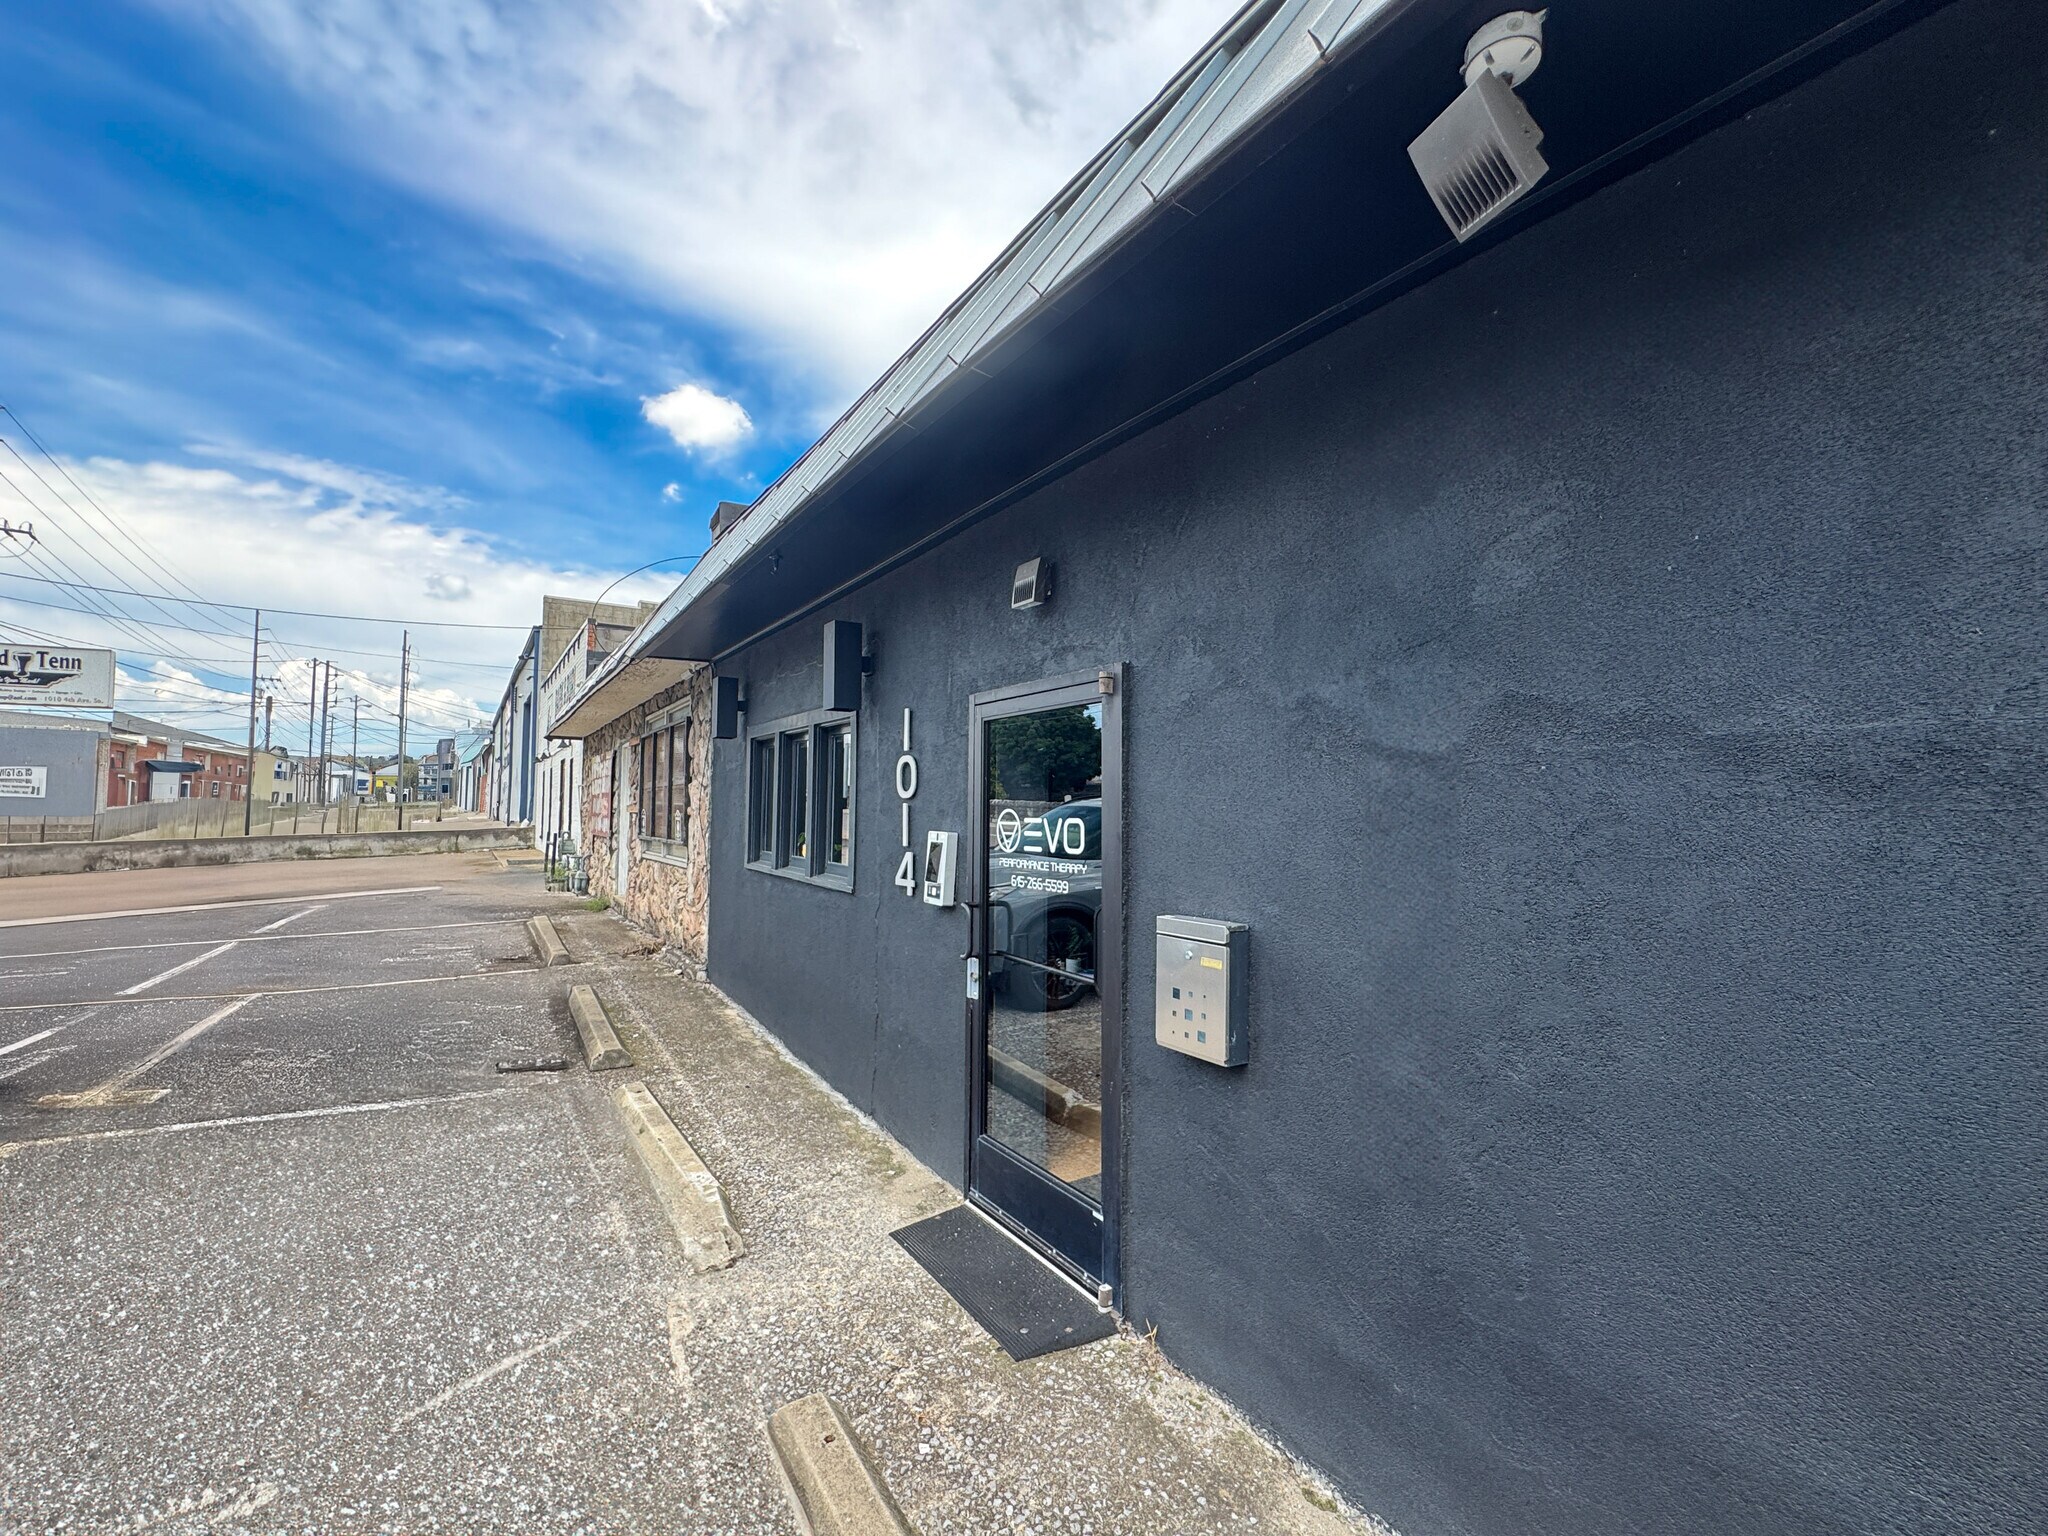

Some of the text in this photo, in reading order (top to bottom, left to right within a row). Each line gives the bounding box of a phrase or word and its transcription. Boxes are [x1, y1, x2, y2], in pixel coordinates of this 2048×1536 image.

[36, 651, 82, 670] Tenn
[895, 707, 918, 896] 1014
[1023, 817, 1085, 855] EVO
[998, 857, 1087, 874] PERFORMANCE THERAPY
[1010, 875, 1069, 894] 615-266-5599
